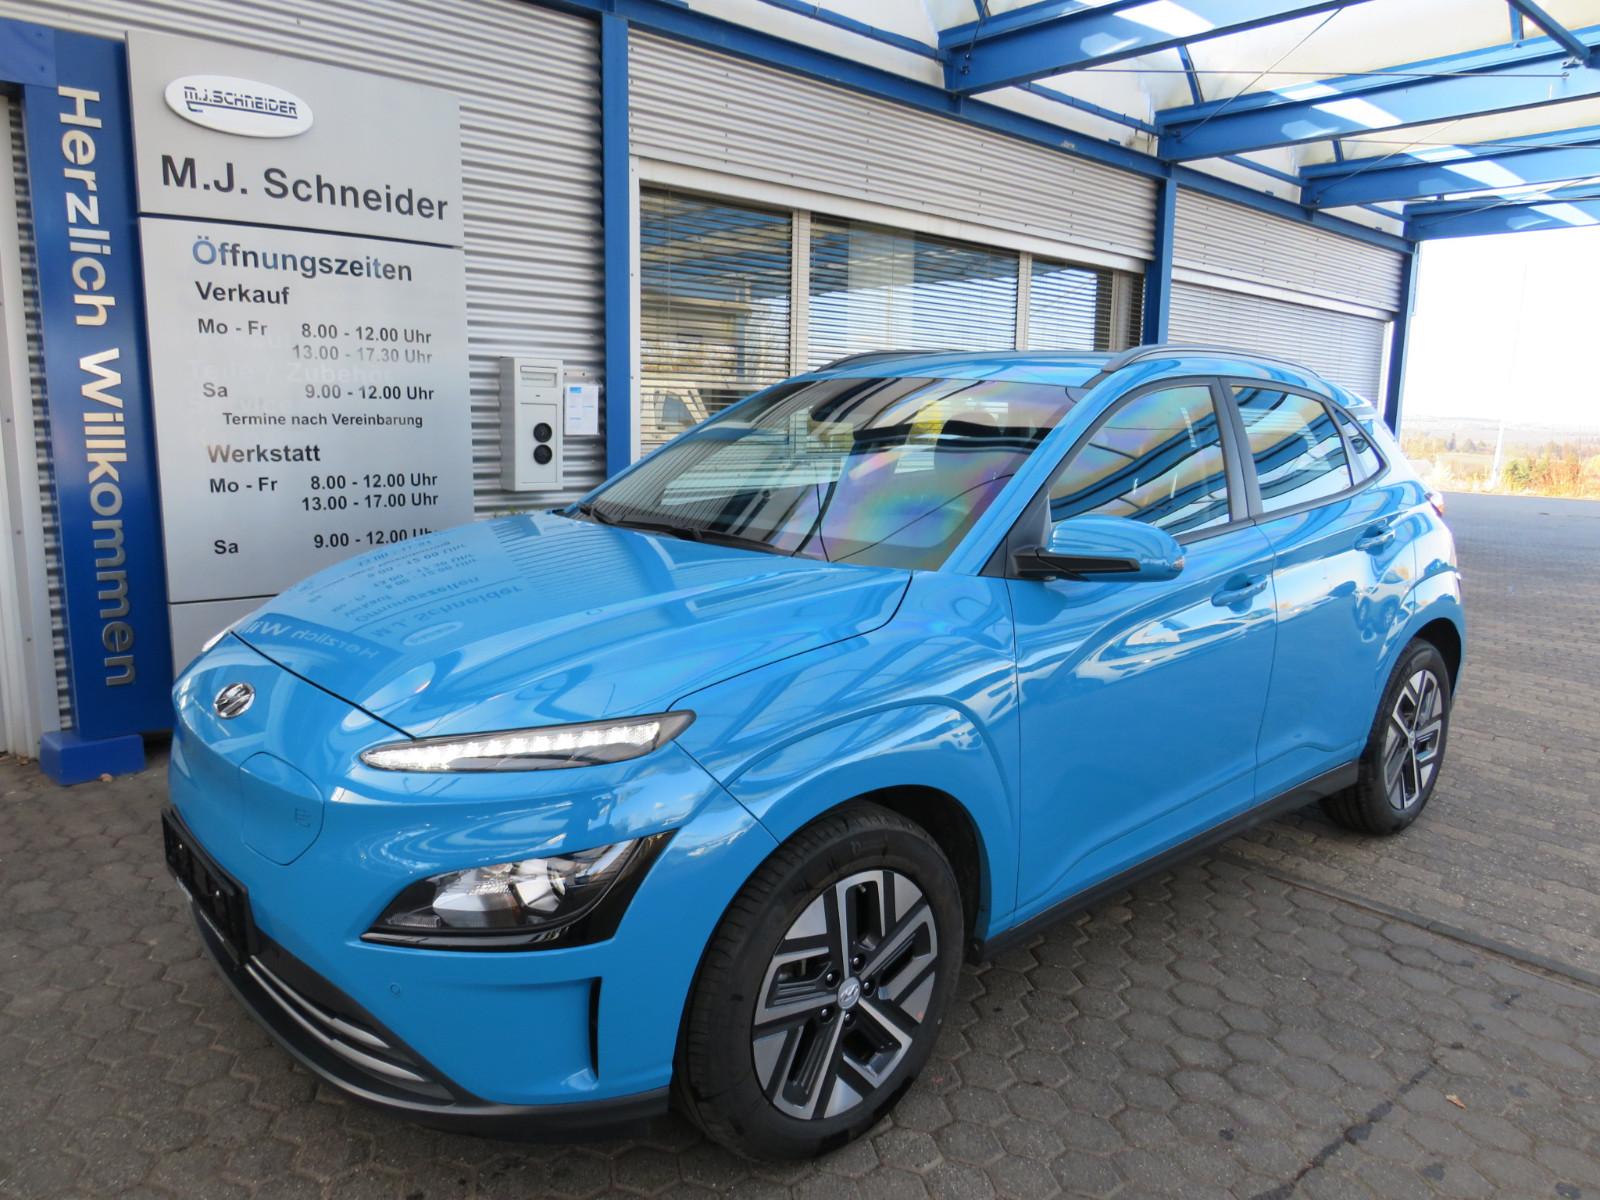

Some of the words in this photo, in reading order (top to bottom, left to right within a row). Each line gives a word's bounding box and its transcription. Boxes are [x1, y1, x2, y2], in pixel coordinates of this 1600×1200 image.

[161, 154, 248, 195] M.J.
[263, 167, 449, 220] Schneider
[57, 84, 116, 326] Herzlich
[192, 235, 413, 282] Öffnungszeiten
[195, 280, 290, 305] Verkauf
[198, 318, 228, 335] Mo
[248, 320, 268, 336] Fr
[301, 323, 338, 339] 8.00
[355, 326, 398, 342] 12.00
[403, 328, 432, 344] Uhr
[292, 345, 339, 361] 13.00
[356, 346, 399, 362] 17.30
[404, 348, 432, 364] Uhr
[202, 382, 228, 398] Sa
[305, 384, 341, 399] 9.00
[358, 385, 401, 400] 12.00
[406, 385, 435, 401] Uhr
[222, 412, 286, 426] Termine
[291, 413, 327, 426] nach
[331, 413, 423, 429] Vereinbarung
[207, 443, 321, 463] Werkstatt
[209, 478, 239, 493] Mo
[258, 477, 278, 492] Fr
[310, 475, 346, 491] 8.00
[362, 473, 405, 489] 12.00
[410, 472, 438, 488] Uhr
[301, 496, 347, 512] 13.00
[364, 494, 406, 509] 17.00
[411, 492, 439, 508] Uhr
[79, 347, 136, 687] Willkommen
[214, 539, 239, 555] Sa
[313, 533, 350, 548] 9.00
[366, 529, 408, 545] 12.00
